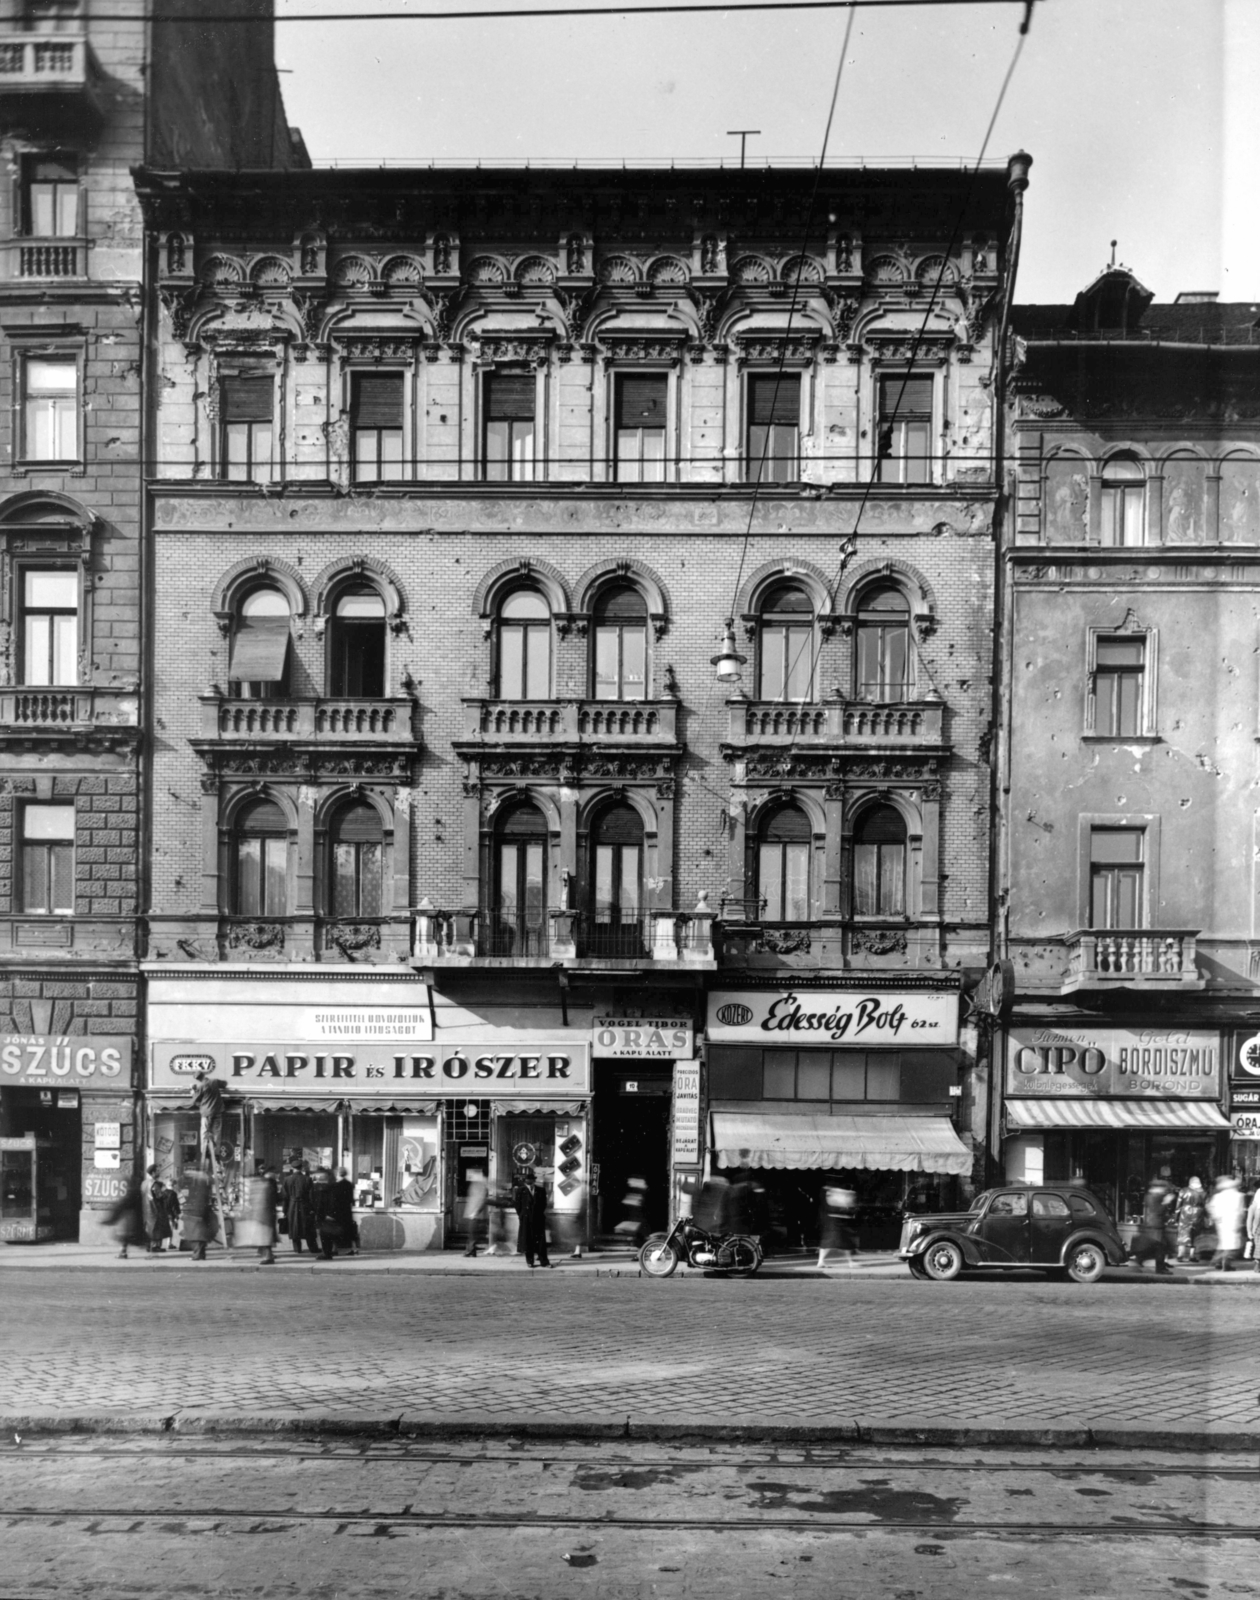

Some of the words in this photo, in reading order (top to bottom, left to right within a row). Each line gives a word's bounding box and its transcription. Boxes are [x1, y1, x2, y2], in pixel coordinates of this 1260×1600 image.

[315, 1014, 365, 1023] SZERETETTEL
[599, 1020, 642, 1028] VOGEL
[647, 1020, 688, 1028] TIBOR
[760, 992, 853, 1040] Édesség
[911, 1018, 927, 1029] 62
[4, 1034, 45, 1045] JÓNÁS
[597, 1026, 689, 1049] ÓRÁS
[1139, 1030, 1193, 1046] Gold
[1, 1037, 121, 1077] SZŰCS
[365, 1063, 385, 1079] ÉS
